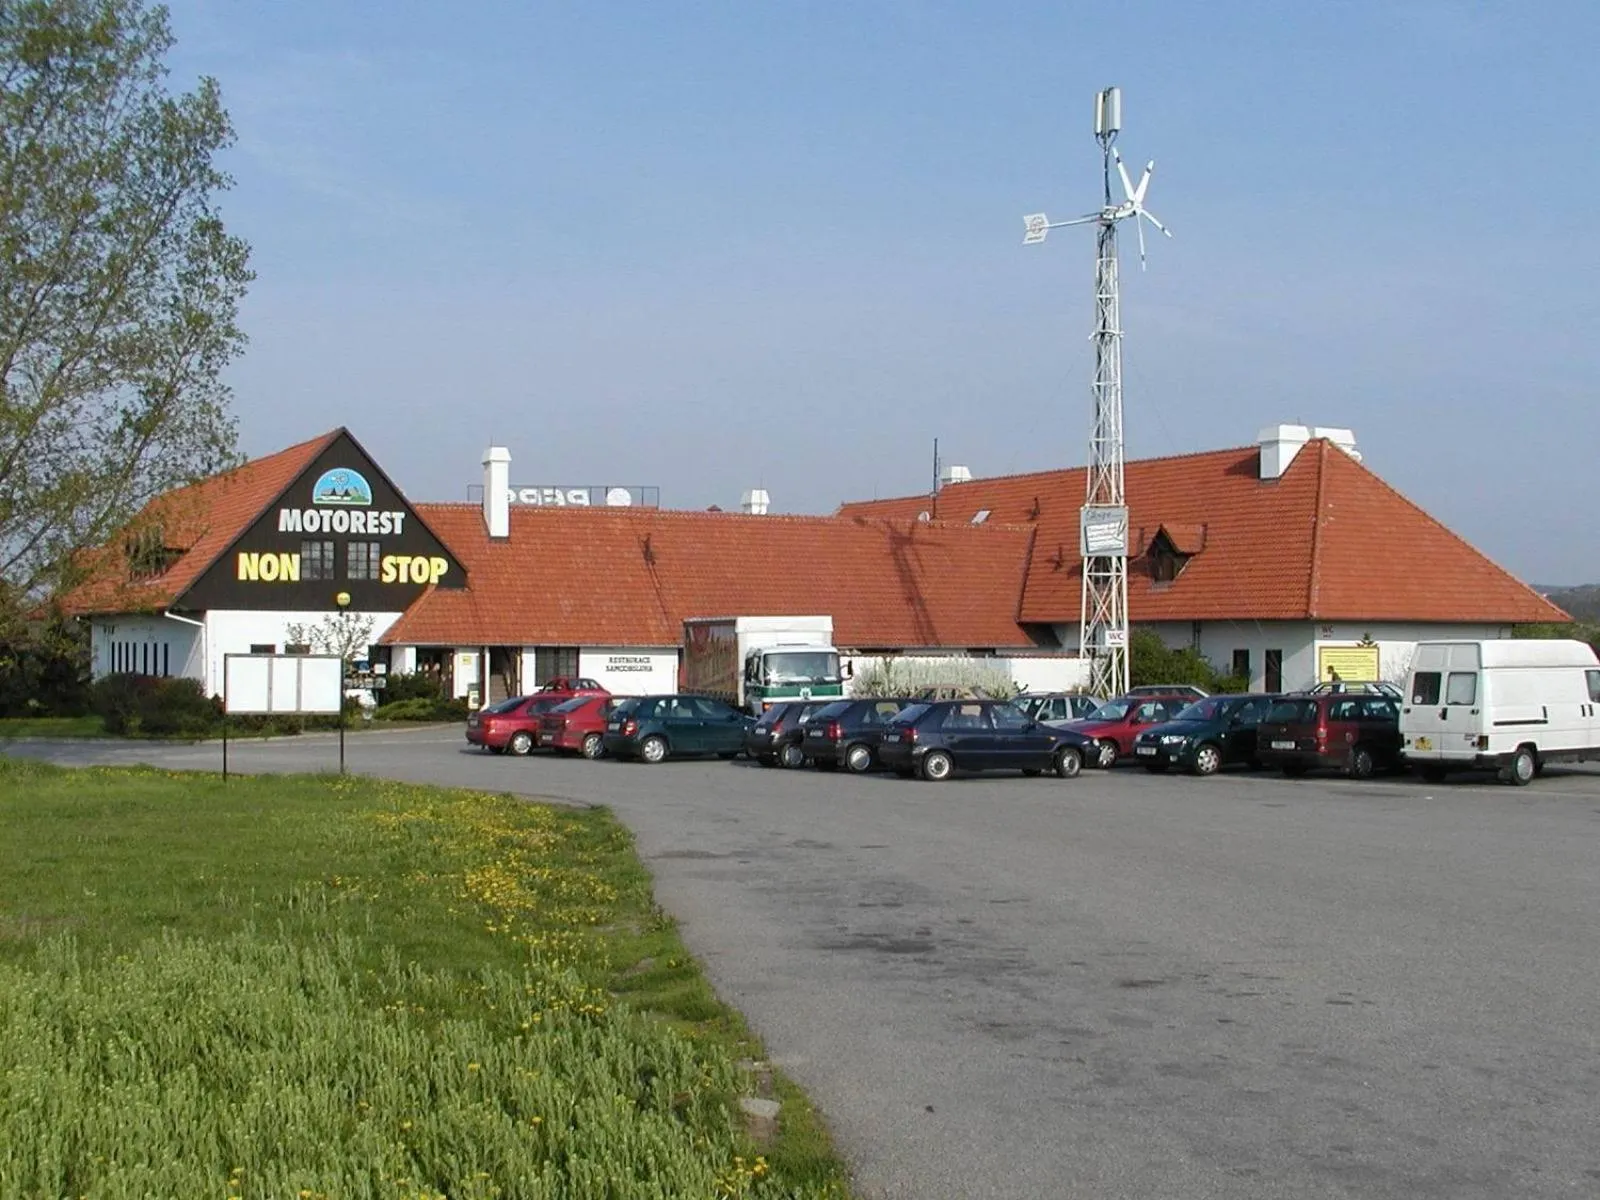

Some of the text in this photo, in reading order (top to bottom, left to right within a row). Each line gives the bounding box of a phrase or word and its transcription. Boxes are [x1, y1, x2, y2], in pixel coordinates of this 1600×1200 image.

[279, 509, 405, 534] MOTOREST
[238, 552, 449, 585] NON STOP
[1108, 632, 1124, 641] WC
